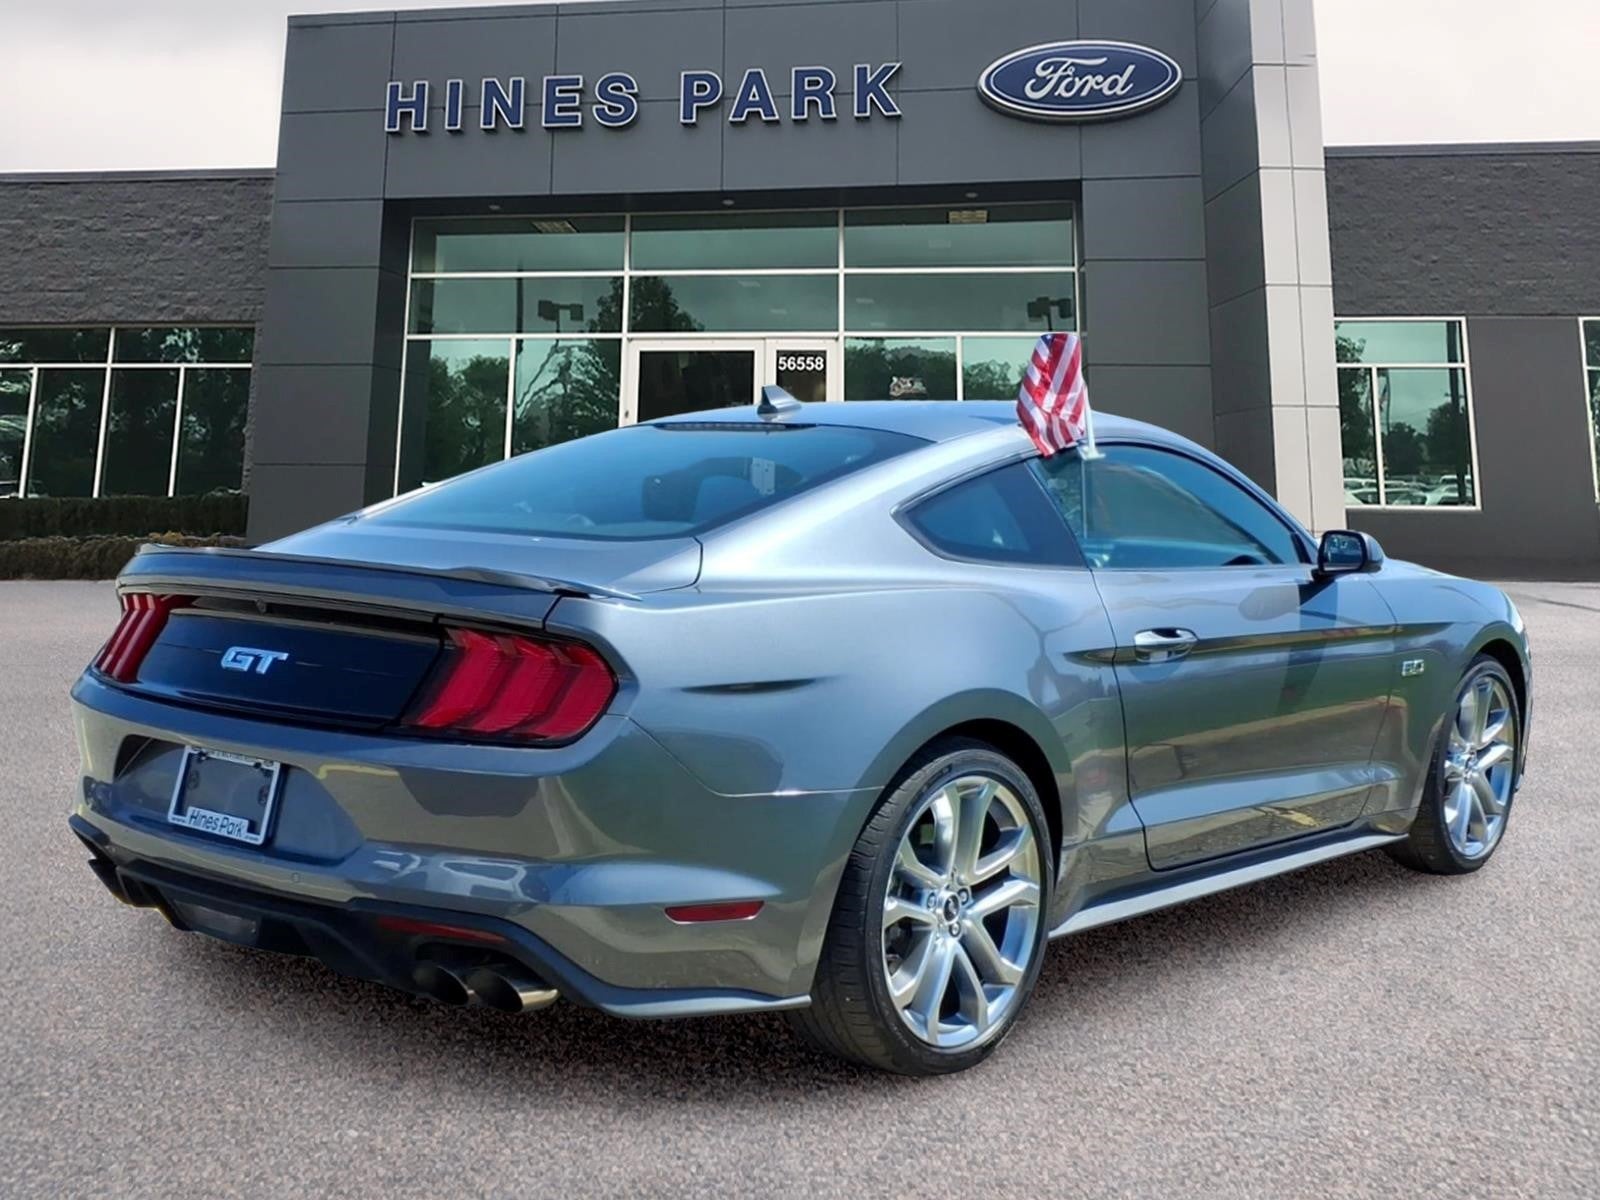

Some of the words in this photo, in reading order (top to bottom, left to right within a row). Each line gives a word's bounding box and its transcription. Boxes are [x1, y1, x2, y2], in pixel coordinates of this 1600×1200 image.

[1024, 56, 1136, 100] Ford
[384, 72, 638, 133] HINES
[679, 62, 903, 124] PARK
[777, 356, 825, 371] 56558
[220, 646, 289, 674] GT
[188, 808, 220, 831] Hines
[218, 816, 244, 839] Park
